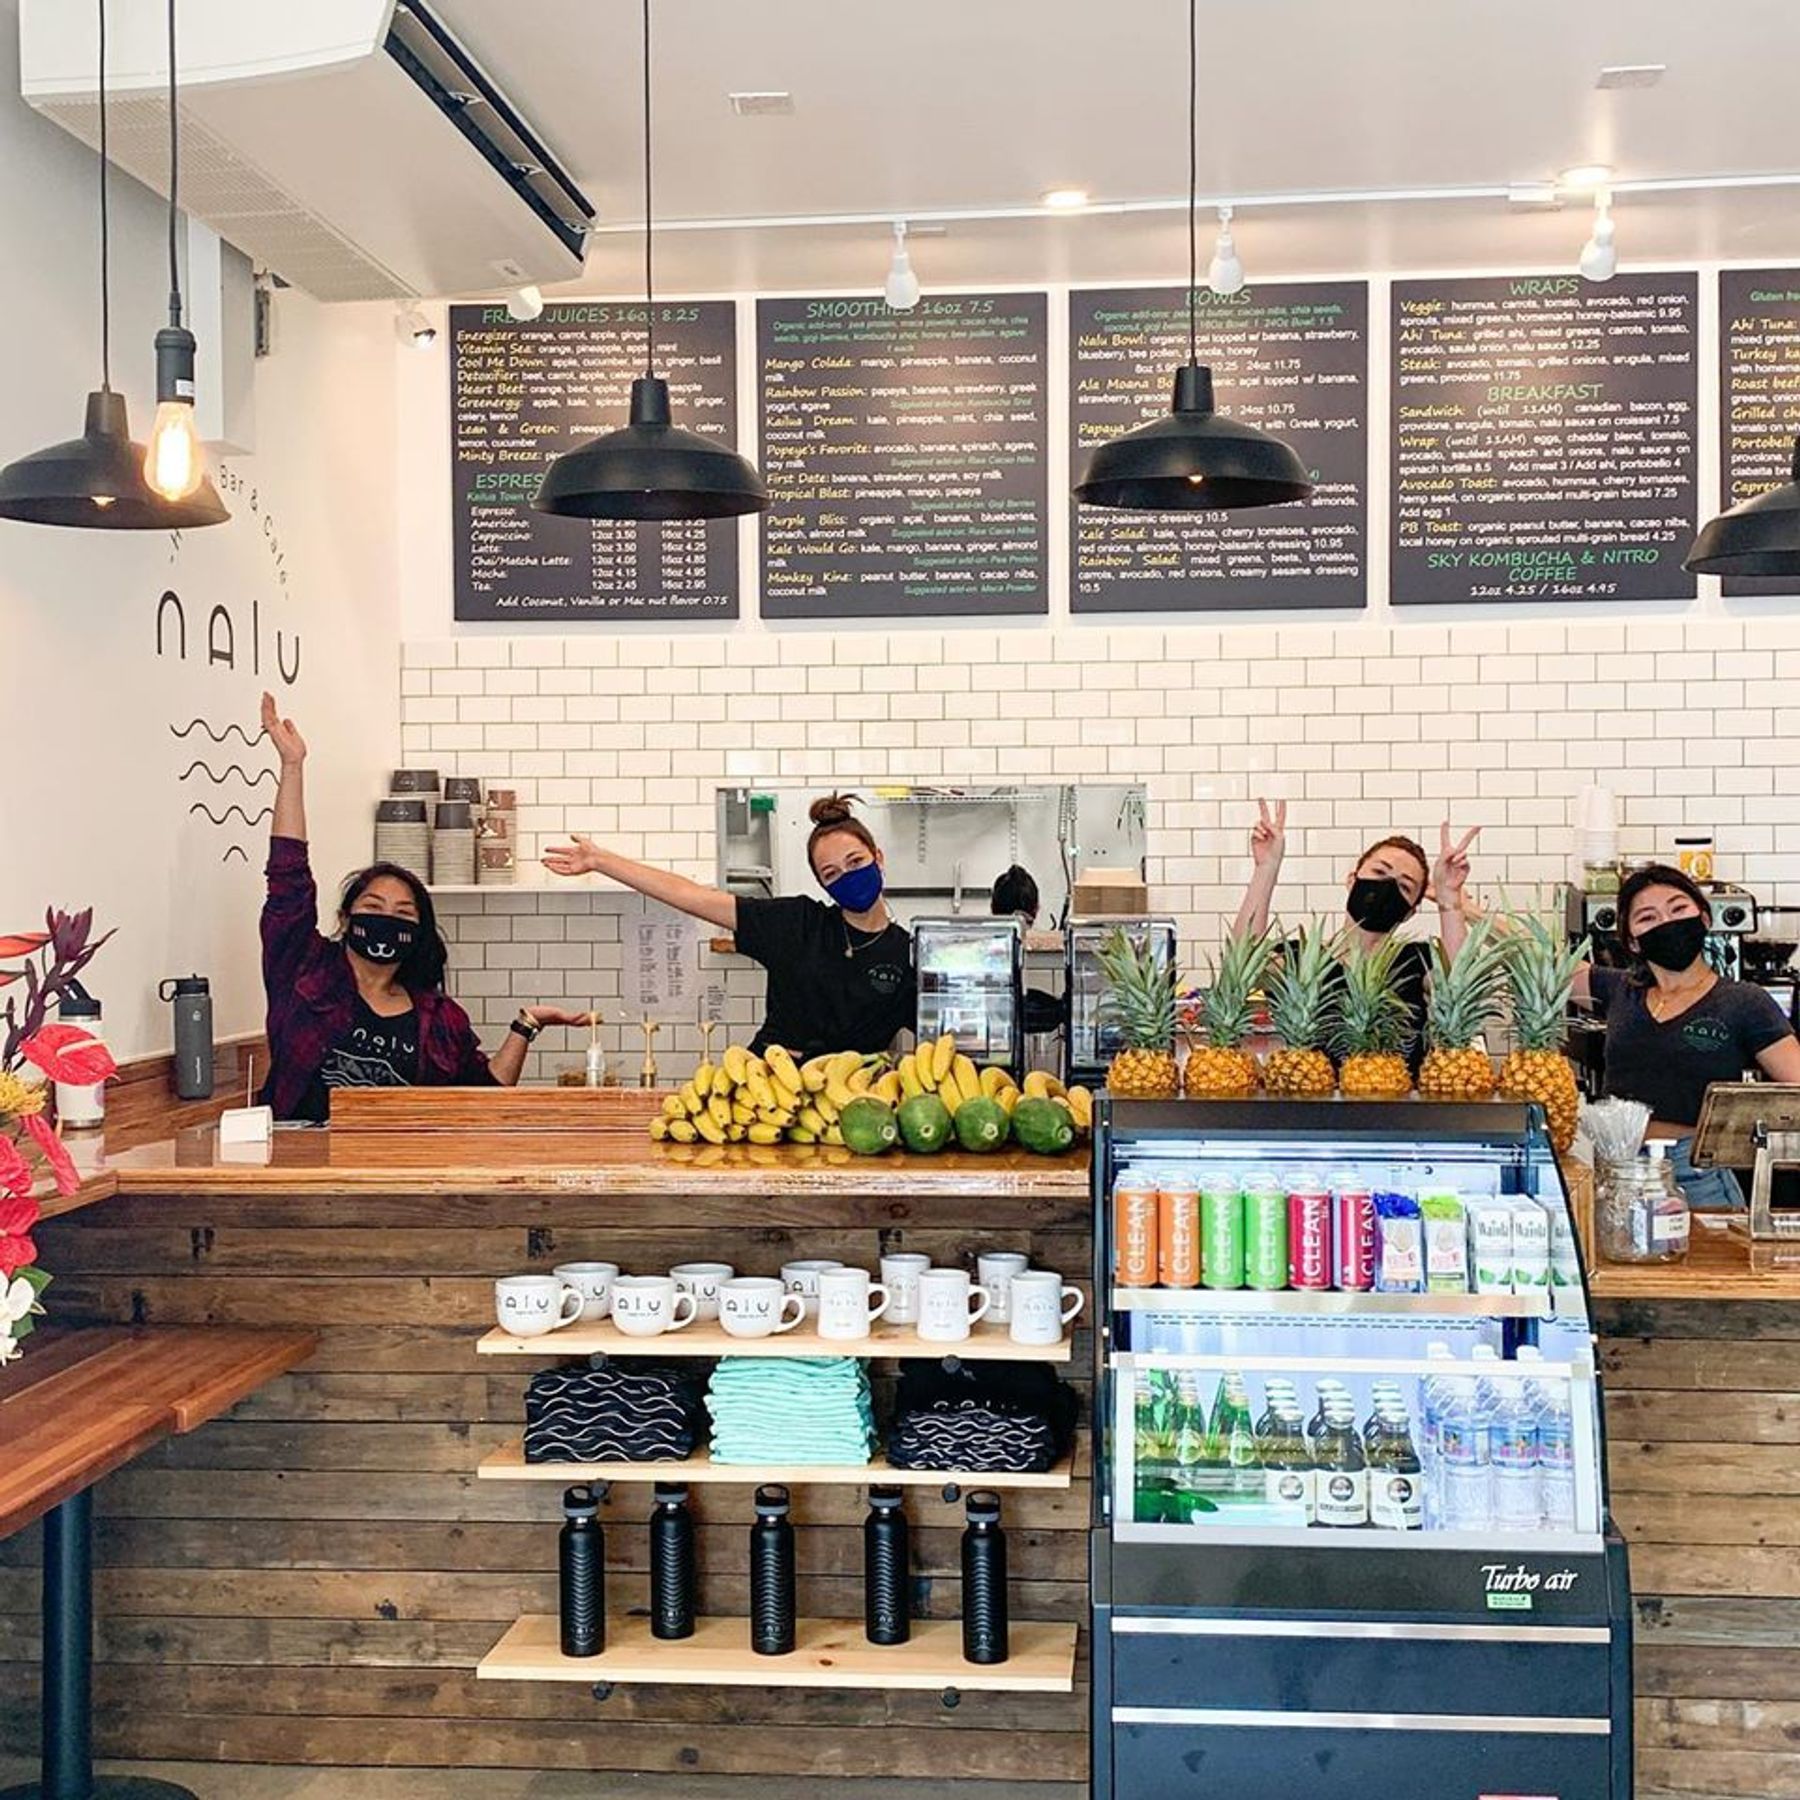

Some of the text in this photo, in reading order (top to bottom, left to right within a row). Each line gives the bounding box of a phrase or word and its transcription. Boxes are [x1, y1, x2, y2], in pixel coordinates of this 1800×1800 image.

[1509, 279, 1579, 296] WRAPS
[546, 308, 610, 322] JUICES
[922, 302, 963, 314] 16oz
[969, 300, 995, 313] 7.5
[1078, 332, 1146, 346] Nalu Bowl:
[1731, 347, 1777, 362] Turkey
[1730, 377, 1768, 389] Roast
[1487, 383, 1604, 401] BREAKFAST
[1730, 406, 1775, 419] Grilled
[1732, 436, 1796, 449] Portobell
[1428, 548, 1659, 567] SKY KOMBUCHA & NITRO
[1508, 566, 1577, 583] COFFEE
[495, 596, 518, 606] Add
[521, 595, 567, 606] Coconut,
[570, 595, 605, 605] Vanilla
[623, 596, 644, 605] Mac
[648, 596, 667, 605] nut
[669, 594, 700, 604] flavor
[1127, 1197, 1146, 1274] CLEAN
[1172, 1197, 1190, 1274] CLEAN
[1213, 1197, 1232, 1275] CLEAN
[1259, 1197, 1277, 1275] CLEAN
[1303, 1198, 1322, 1277] CLEAN
[1480, 1564, 1578, 1591] Turbo air
